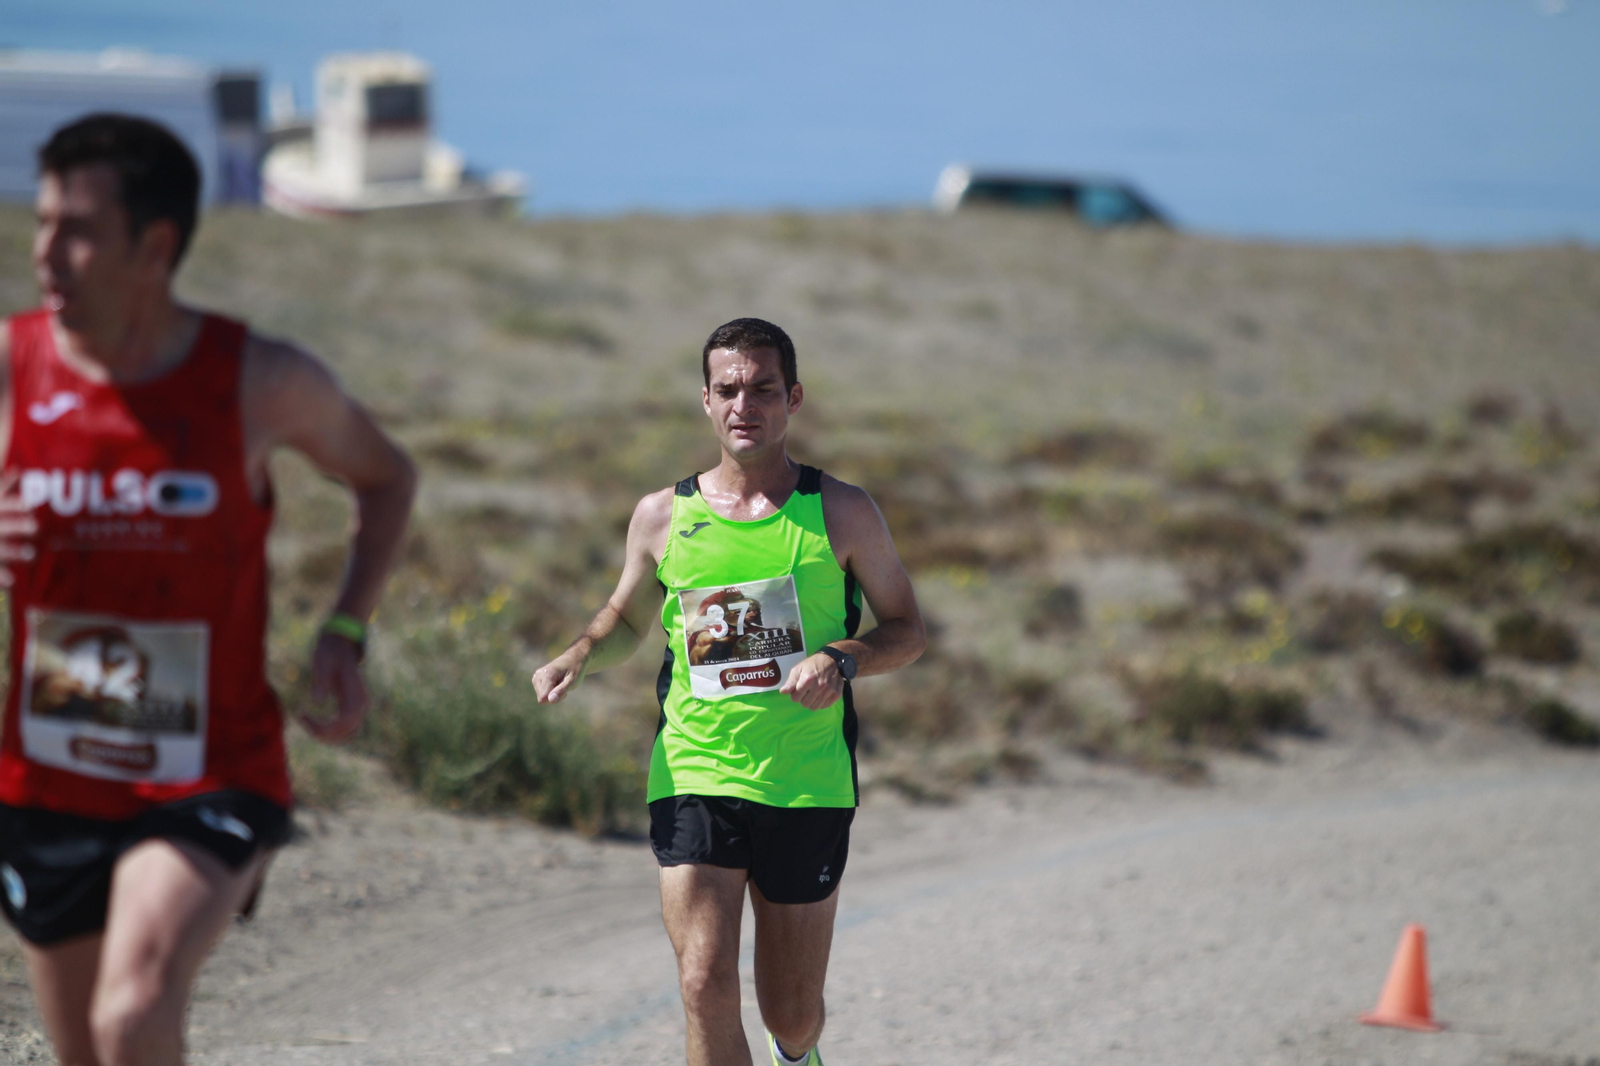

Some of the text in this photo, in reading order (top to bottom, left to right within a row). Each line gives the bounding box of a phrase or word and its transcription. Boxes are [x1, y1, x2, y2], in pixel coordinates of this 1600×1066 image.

[706, 601, 750, 638] 37
[747, 627, 789, 641] XIII
[748, 636, 791, 647] CARRERA
[749, 641, 791, 651] POPULAR
[67, 638, 136, 704] 12
